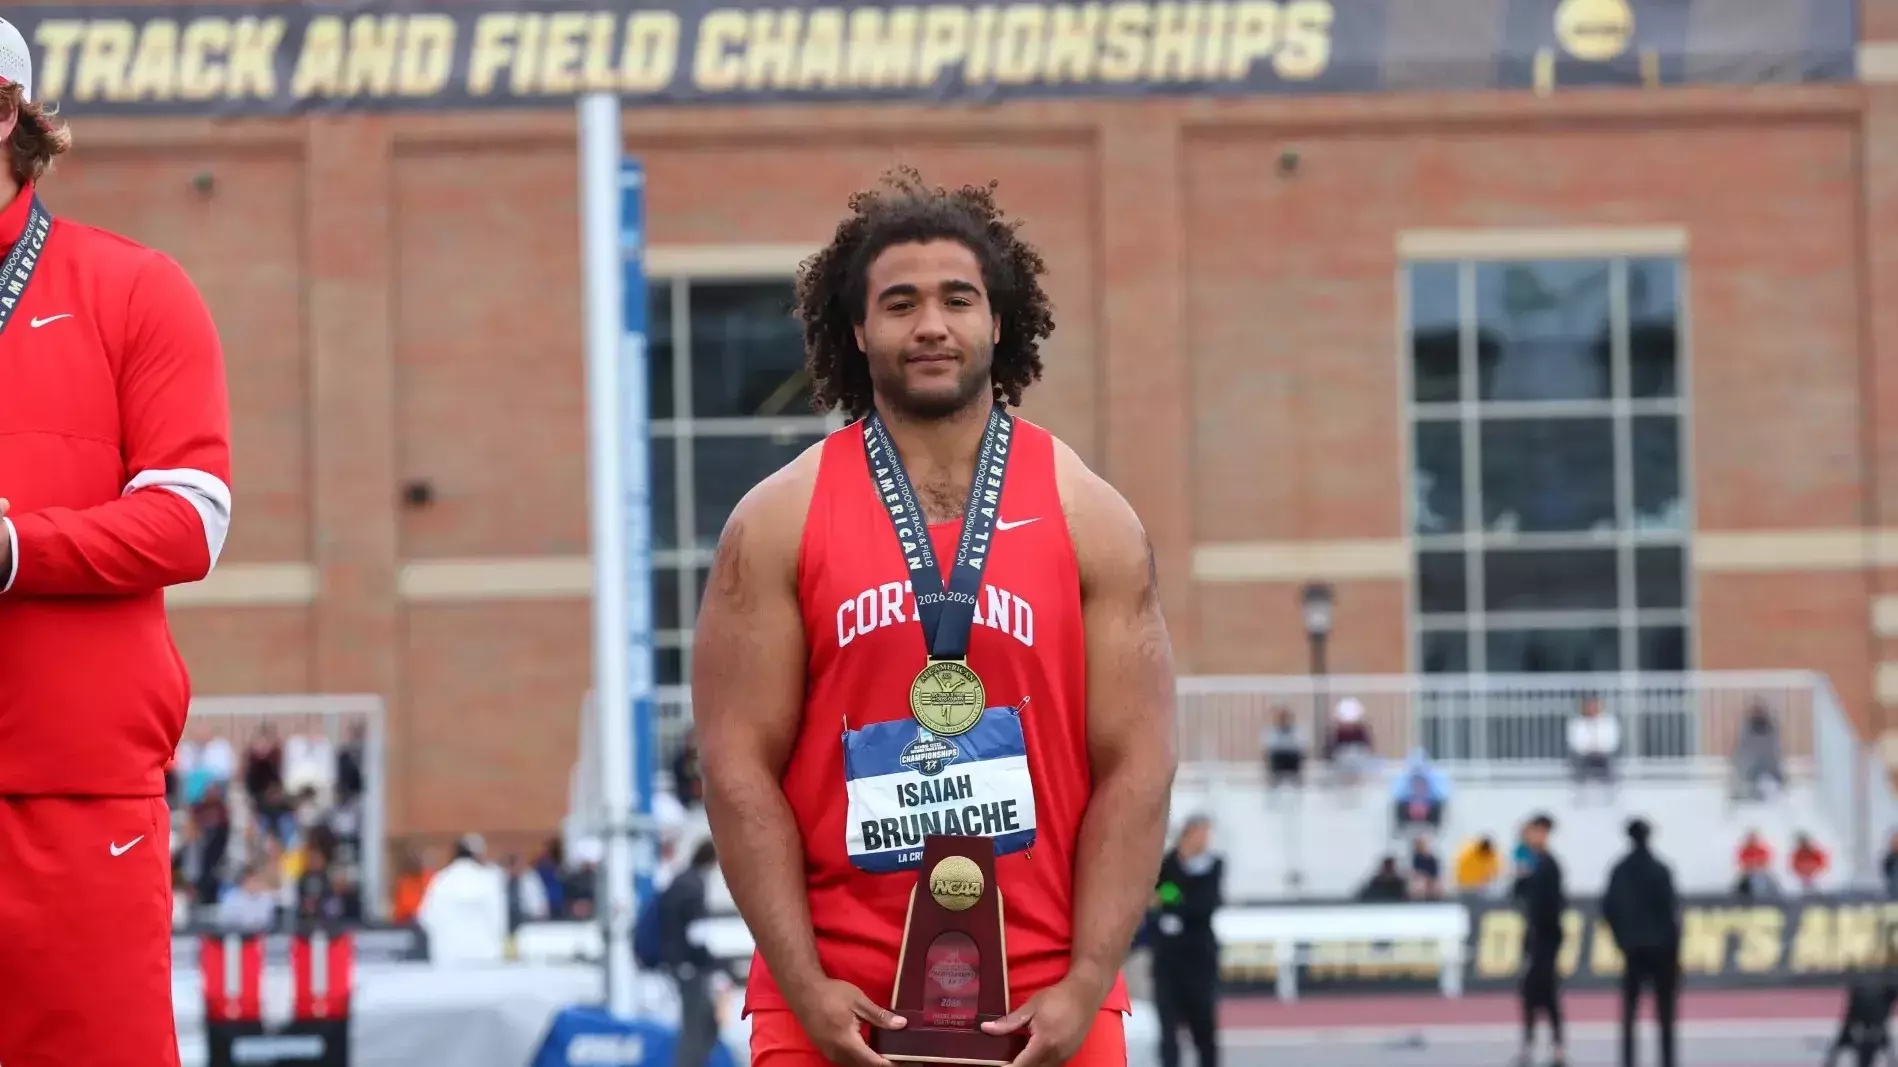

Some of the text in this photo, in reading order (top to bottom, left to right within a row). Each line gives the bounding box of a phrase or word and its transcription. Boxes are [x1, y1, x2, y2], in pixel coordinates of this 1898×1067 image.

[35, 1, 1335, 101] TRACK AND FIELD CHAMPIONSHIPS
[0, 215, 49, 328] -AMERICAN
[863, 426, 923, 570] ALL-AMERICAN
[880, 435, 898, 468] DIVISION
[896, 473, 916, 512] OUTDOOR
[911, 511, 925, 539] TRACK
[920, 544, 934, 567] FIELD
[957, 541, 969, 567] NCAA
[963, 505, 978, 541] DIVISION
[972, 458, 989, 498] OUTDOOR
[982, 435, 994, 459] TRACK
[989, 411, 998, 431] FIELD
[969, 418, 1011, 570] ALL-AMERICAN
[836, 580, 1034, 648] CORND
[918, 592, 946, 605] 2026
[947, 591, 976, 605] 2026
[902, 749, 957, 763] CHAMPIONSHIPS
[896, 774, 973, 808] ISAIAH
[861, 799, 1019, 851] BRUNACHE
[898, 853, 907, 863] LA
[933, 880, 982, 897] NCAA
